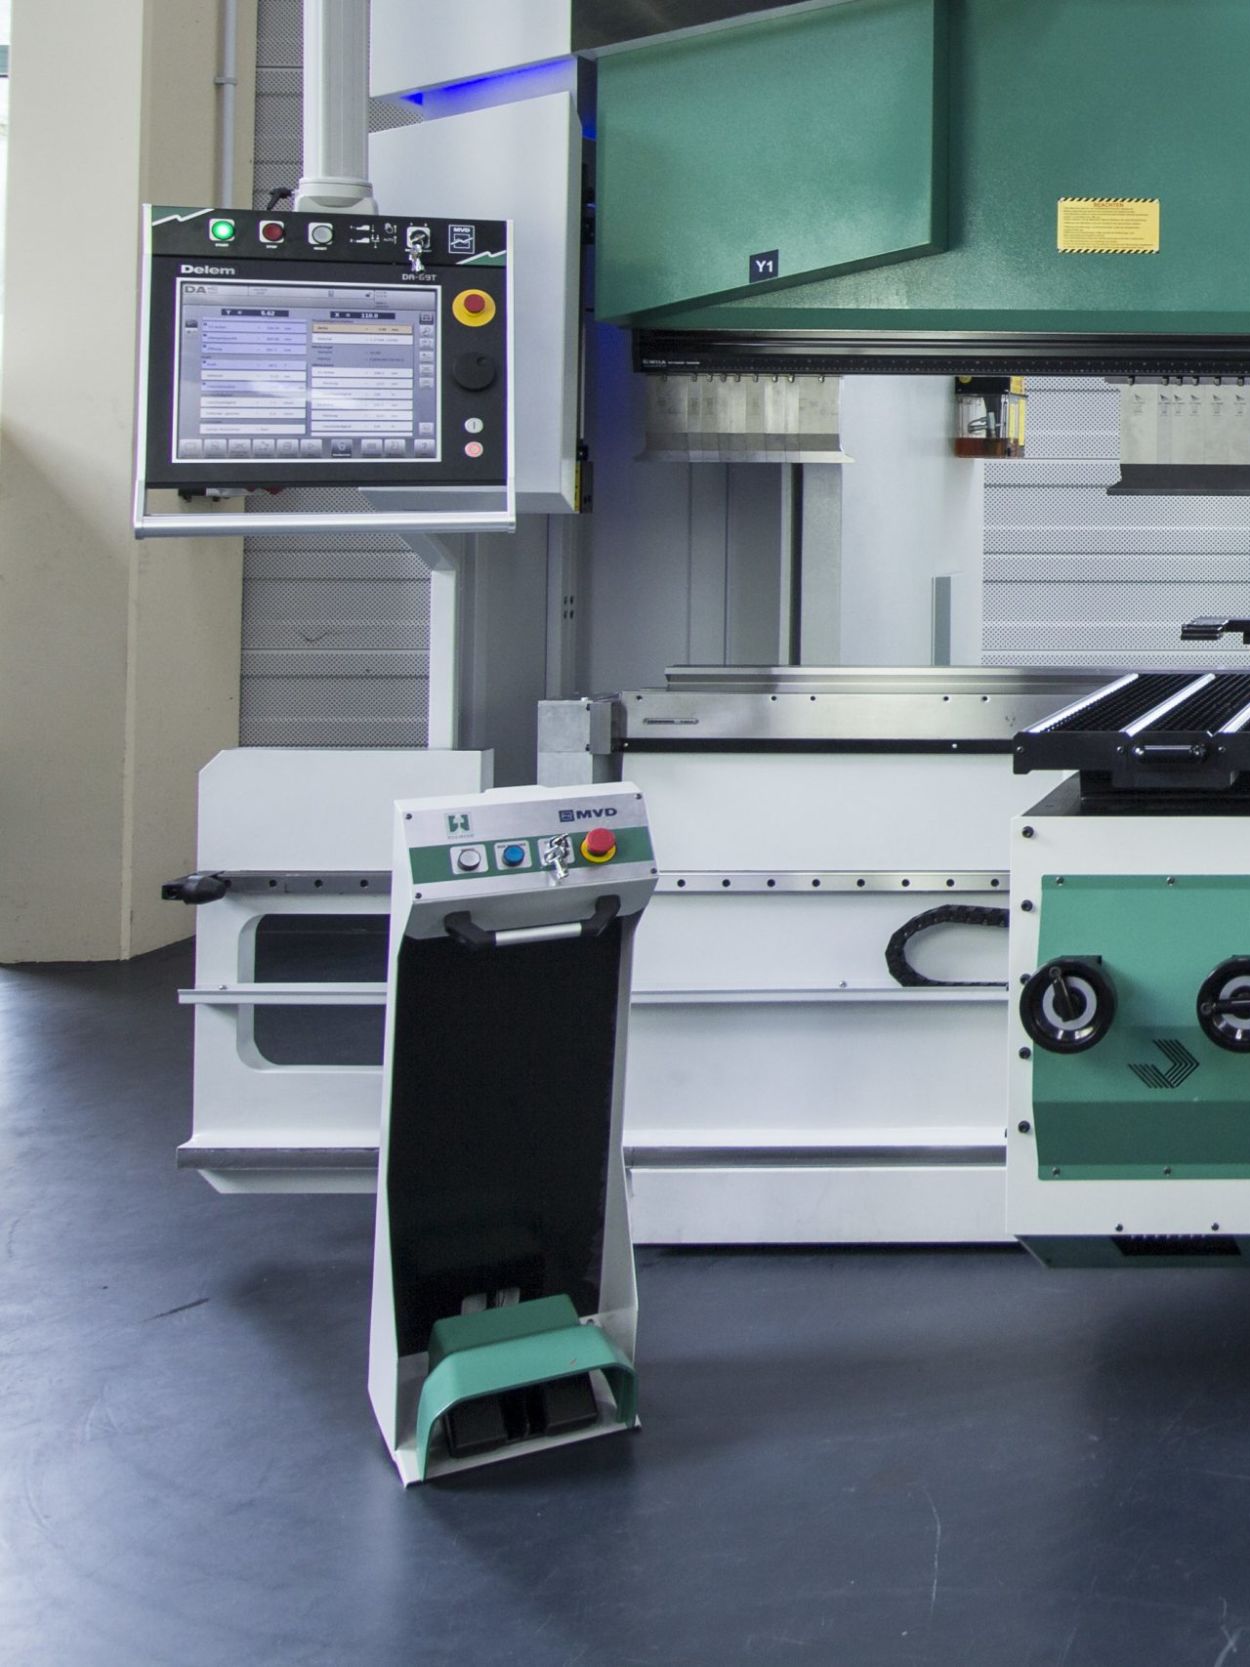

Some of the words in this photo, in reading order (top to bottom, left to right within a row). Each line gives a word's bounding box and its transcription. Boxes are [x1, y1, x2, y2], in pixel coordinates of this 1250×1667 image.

[180, 264, 236, 276] Delem
[755, 260, 774, 273] Y1
[575, 807, 618, 820] MVD
